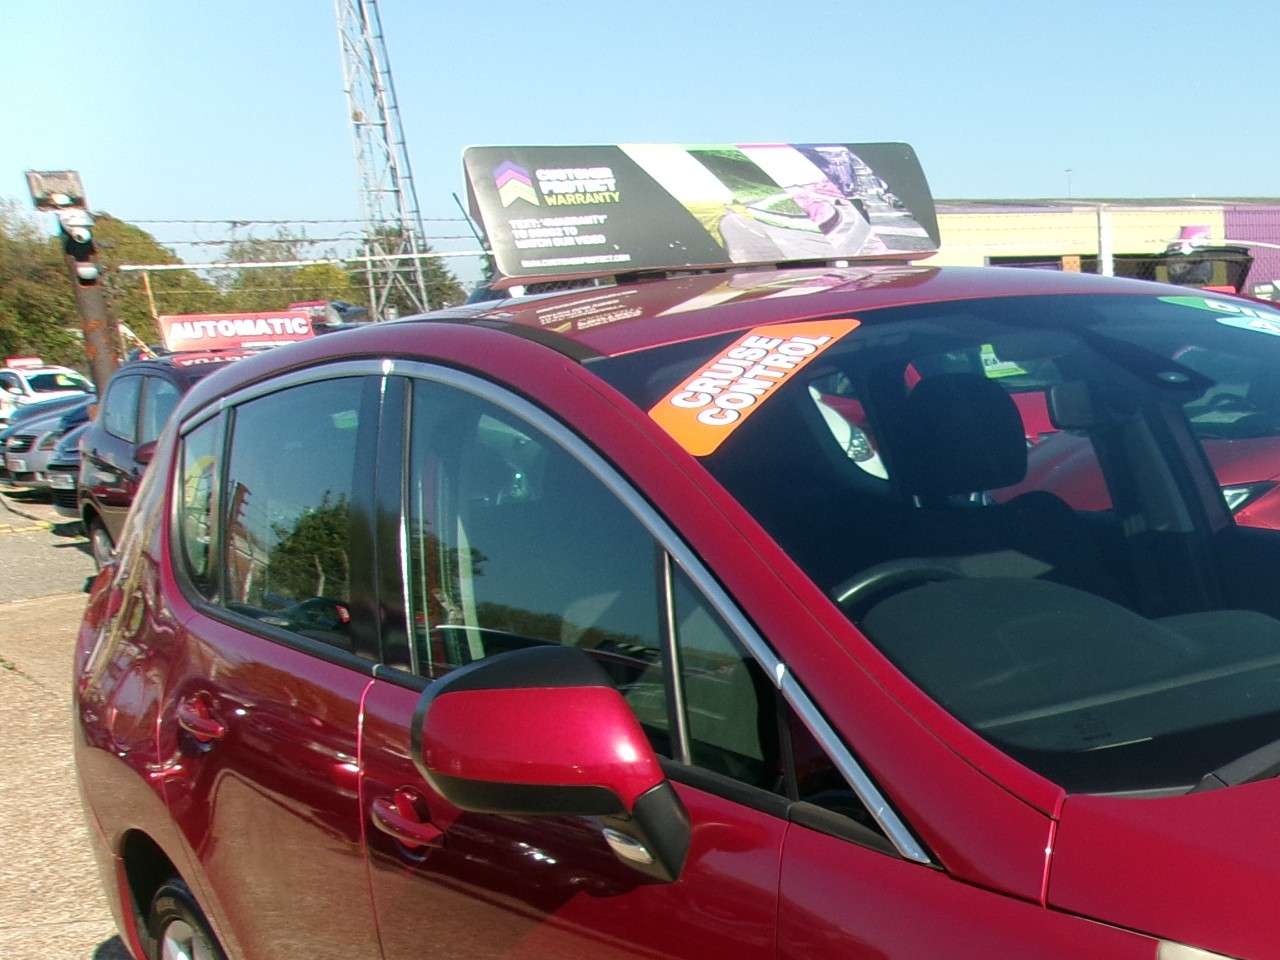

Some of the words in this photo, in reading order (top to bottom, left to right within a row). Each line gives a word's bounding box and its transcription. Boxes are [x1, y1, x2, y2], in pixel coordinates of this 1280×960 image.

[539, 179, 616, 194] PROTECT
[544, 191, 620, 206] WARRANTY
[169, 317, 309, 340] AUTOMATIC
[670, 335, 785, 409] CRUISE
[697, 333, 834, 426] CONTROL
